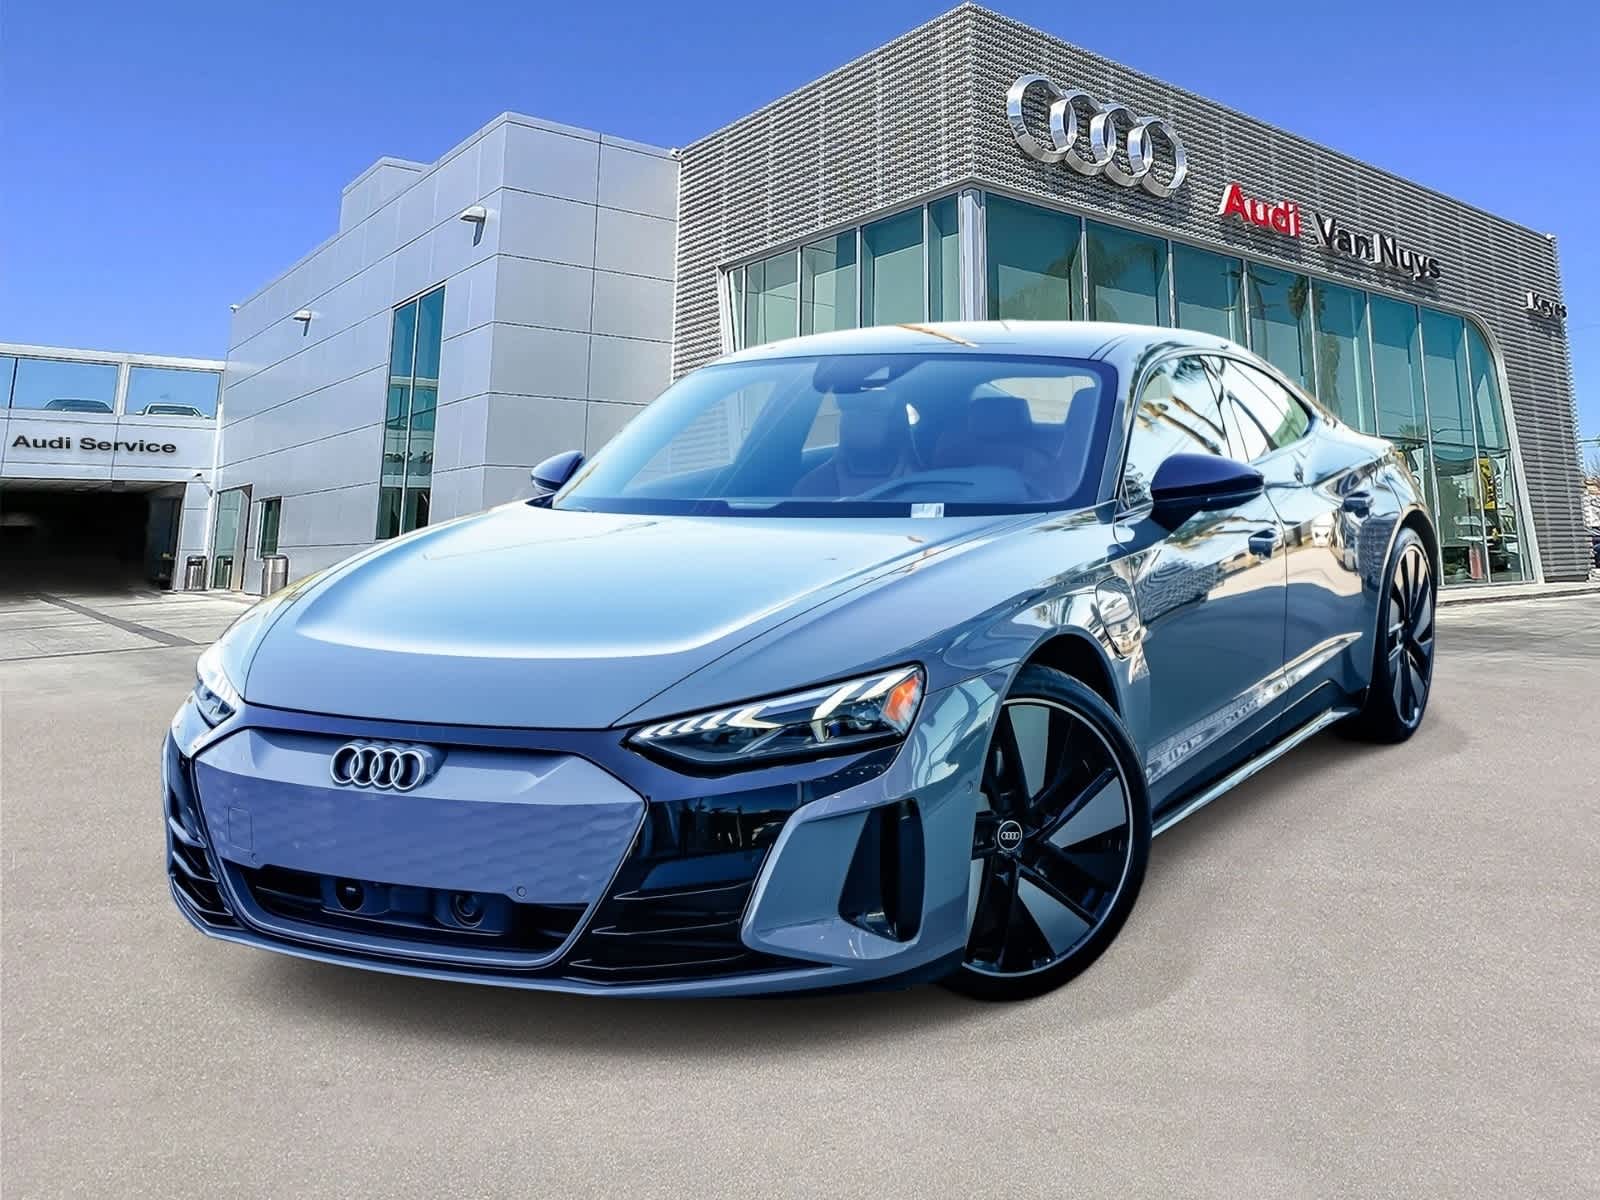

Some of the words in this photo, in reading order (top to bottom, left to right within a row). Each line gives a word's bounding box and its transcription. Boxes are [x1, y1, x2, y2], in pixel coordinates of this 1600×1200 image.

[1217, 182, 1304, 237] Audi
[1312, 211, 1374, 259] Van
[1374, 233, 1442, 281] Nuys
[12, 434, 71, 449] Audi
[80, 437, 177, 453] Service
